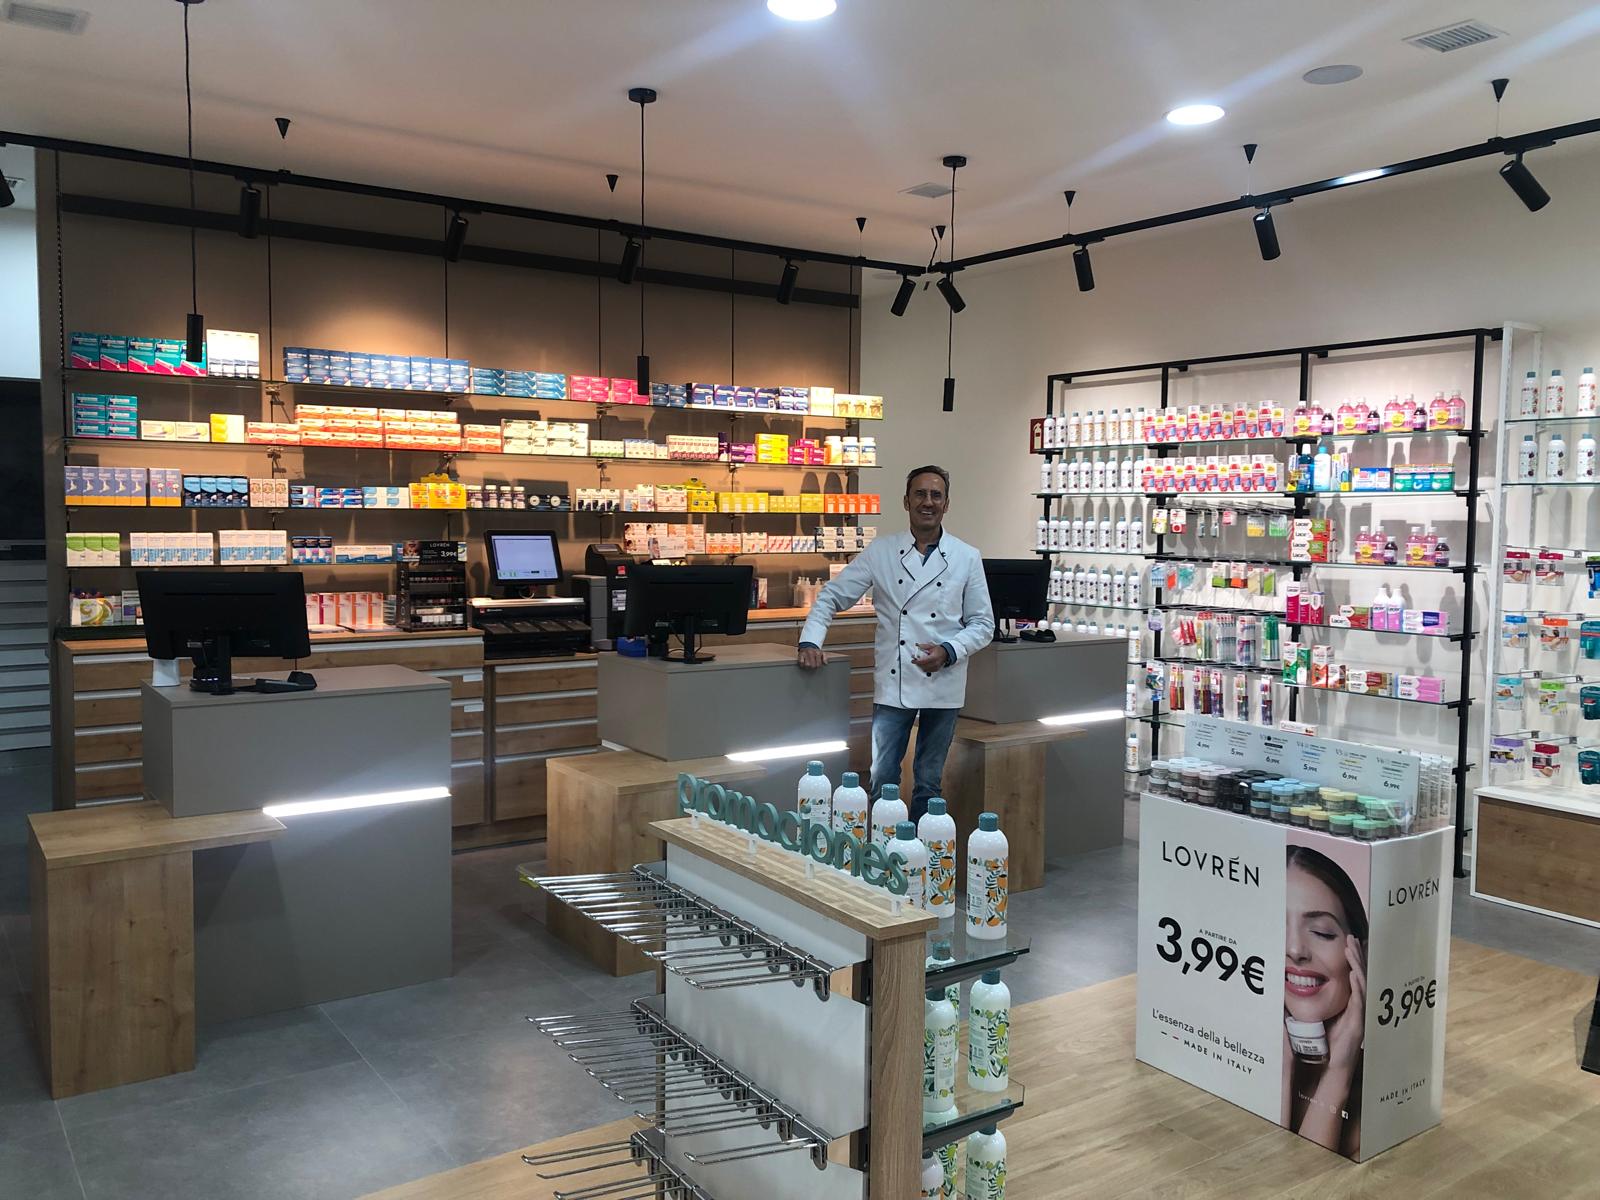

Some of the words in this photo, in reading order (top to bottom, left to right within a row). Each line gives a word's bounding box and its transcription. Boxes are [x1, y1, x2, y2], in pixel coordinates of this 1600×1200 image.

[1162, 841, 1260, 888] LOVRÉN
[1156, 916, 1265, 995] 3,99€
[1204, 930, 1228, 942] PARTIRE
[1228, 938, 1238, 946] DA
[1377, 979, 1437, 1028] 3,99€
[1152, 1007, 1195, 1034] L'essenza
[1197, 1027, 1221, 1045] della
[1223, 1037, 1265, 1065] bellezza
[1183, 1040, 1208, 1056] MADE
[1212, 1052, 1222, 1061] IN
[1227, 1058, 1253, 1075] ITALY
